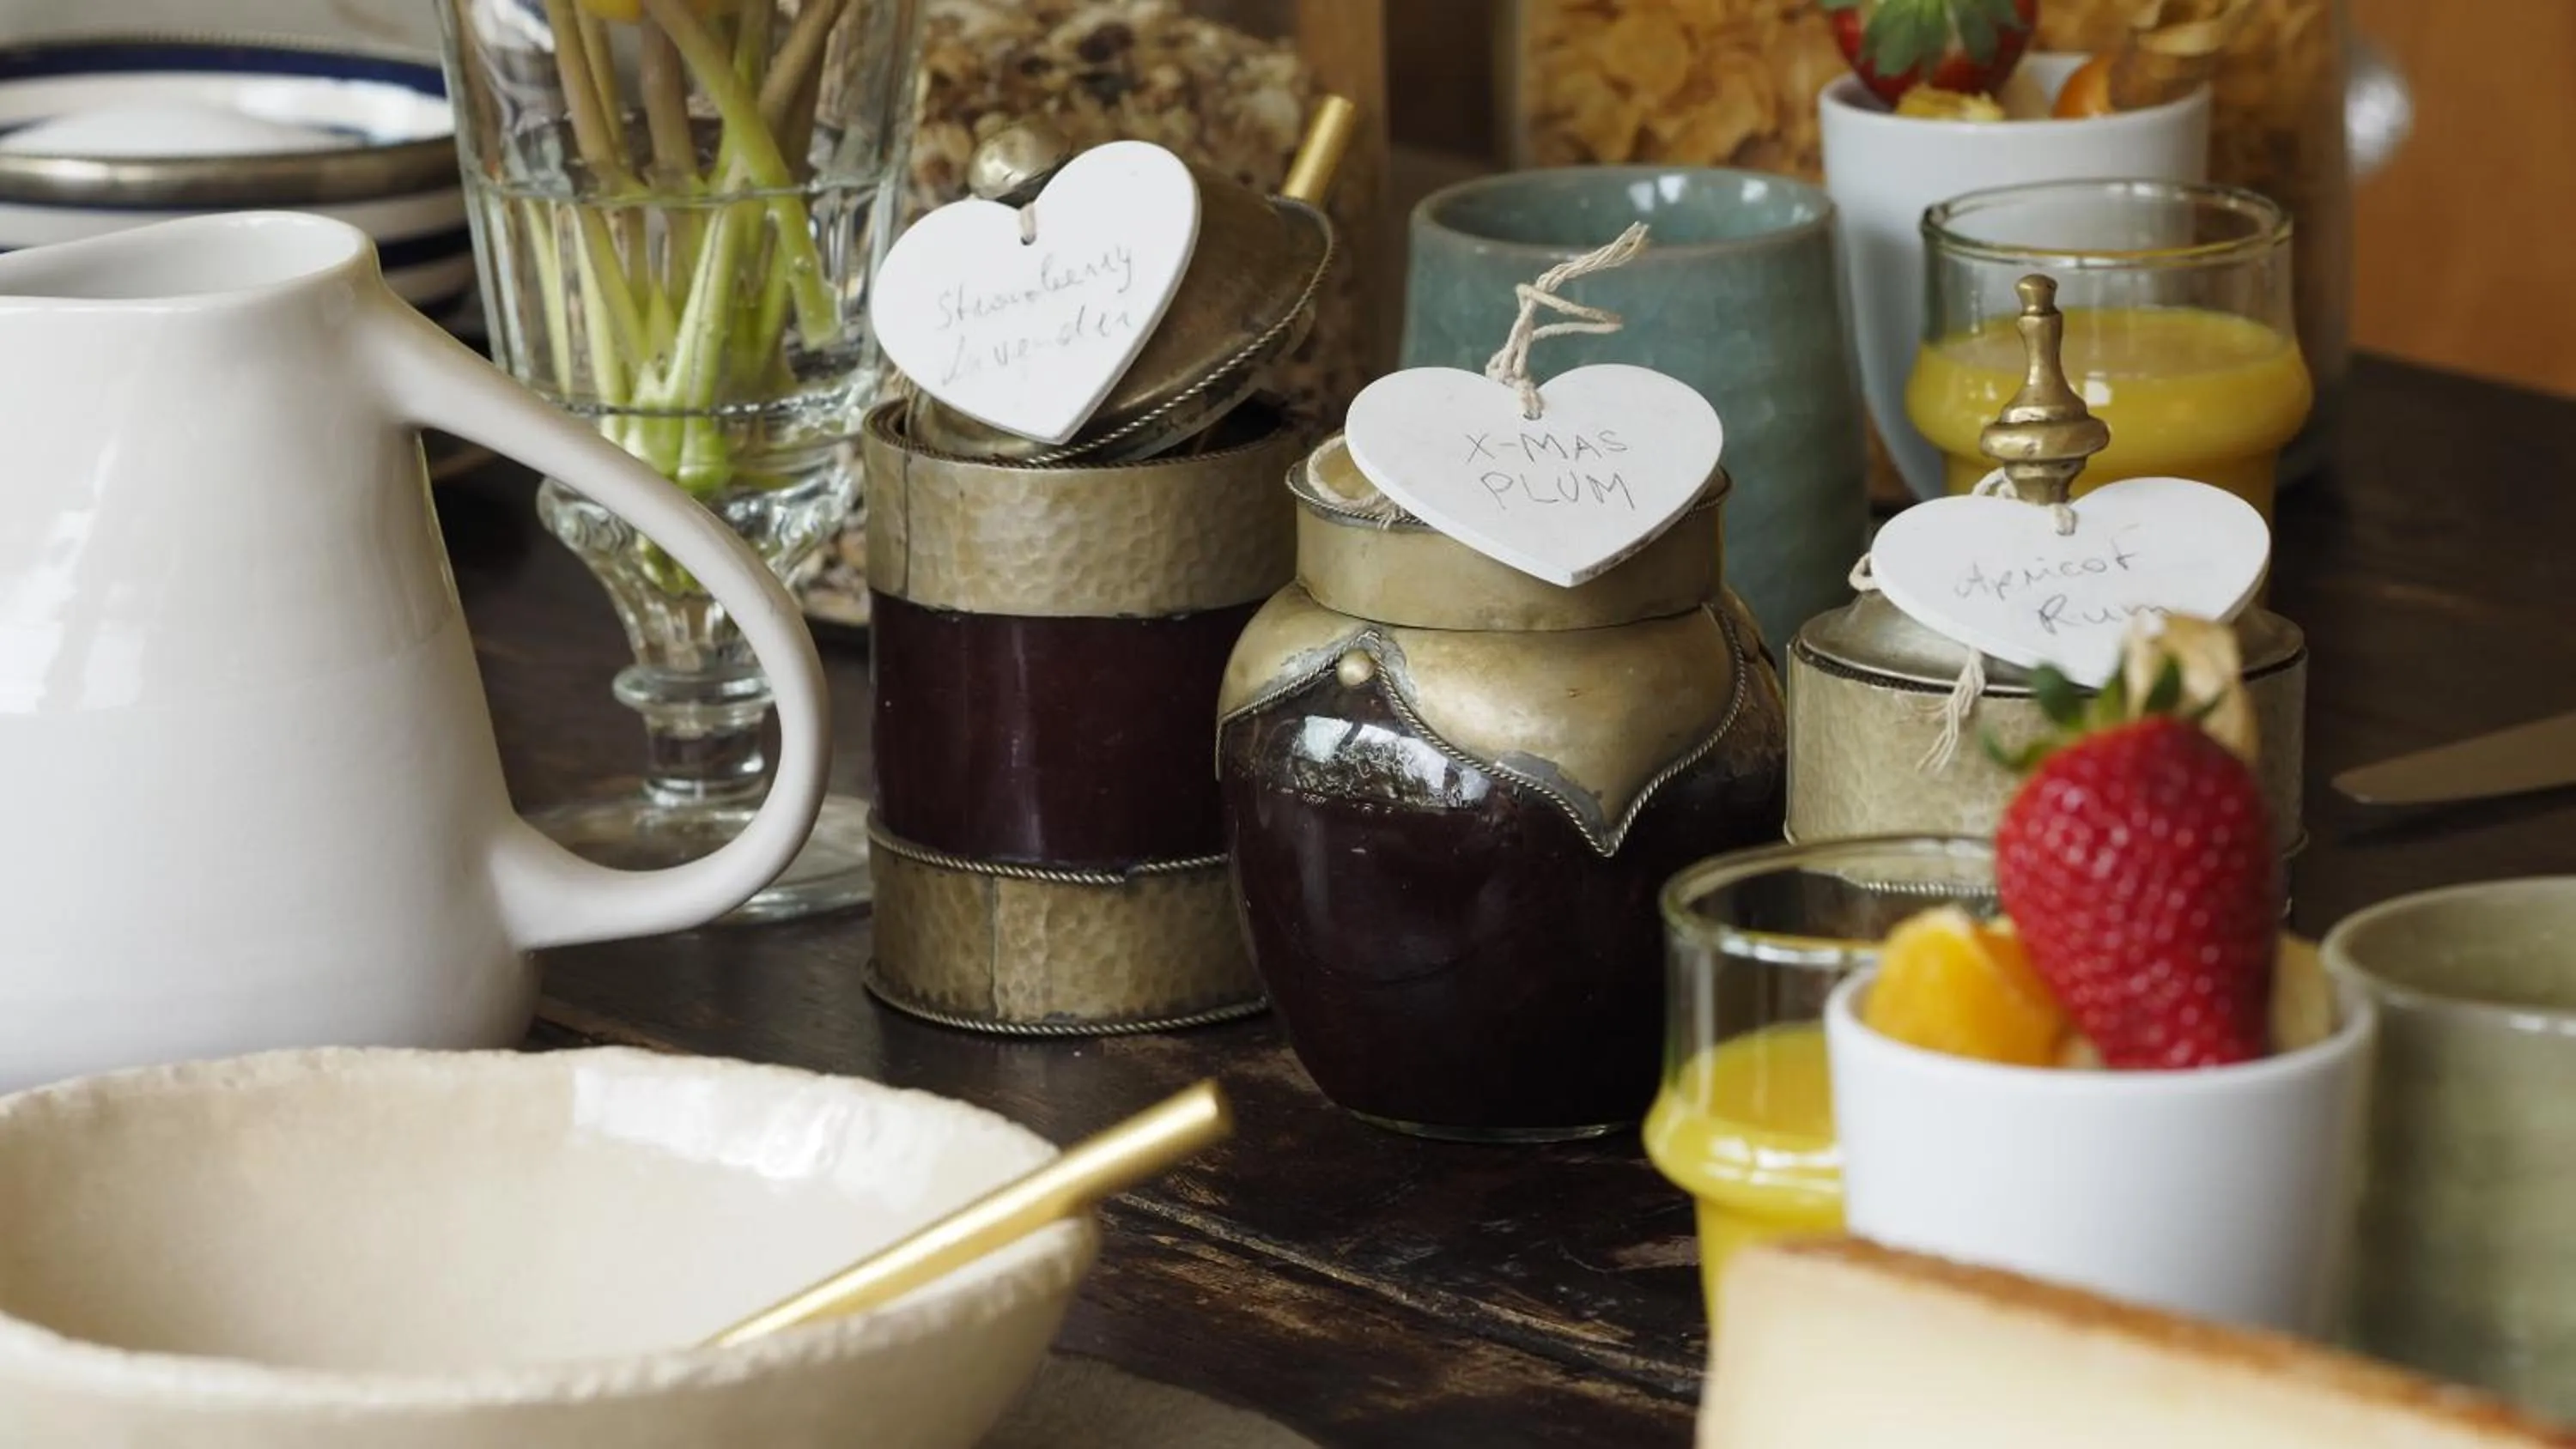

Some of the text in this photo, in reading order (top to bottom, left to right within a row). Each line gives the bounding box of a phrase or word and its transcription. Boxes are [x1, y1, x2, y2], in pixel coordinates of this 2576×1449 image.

[1464, 428, 1630, 464] X-MAS
[1479, 470, 1636, 511] PLUM
[1953, 523, 2142, 602] Apricot
